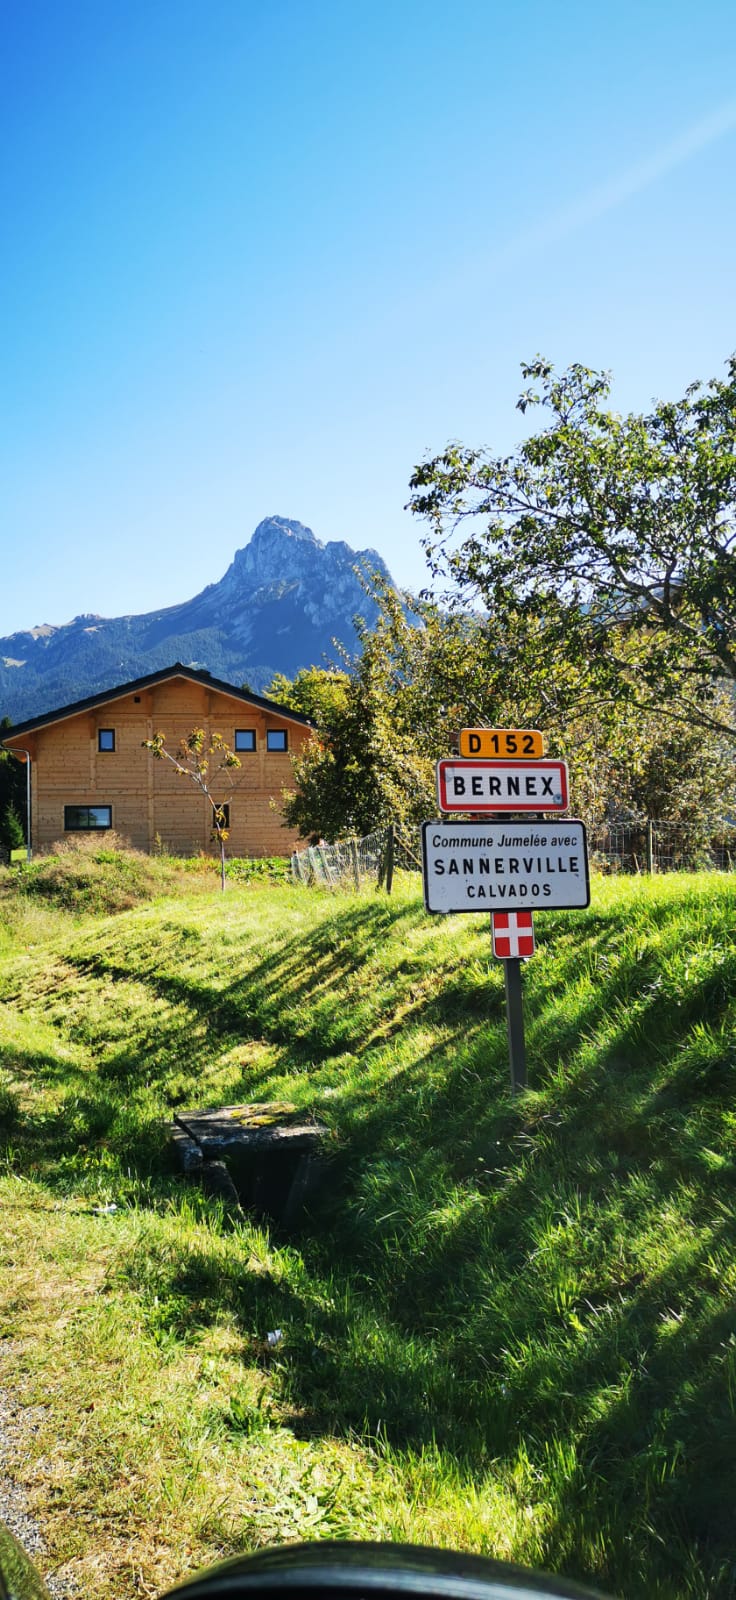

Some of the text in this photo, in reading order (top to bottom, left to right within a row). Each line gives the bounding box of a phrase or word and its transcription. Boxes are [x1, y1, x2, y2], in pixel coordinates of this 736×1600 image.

[469, 734, 535, 754] D 152
[453, 776, 554, 796] BERNEX
[432, 833, 578, 848] Commune Jumelée avec
[434, 856, 579, 875] SANNERVILLE
[467, 883, 551, 898] CALVADOS
